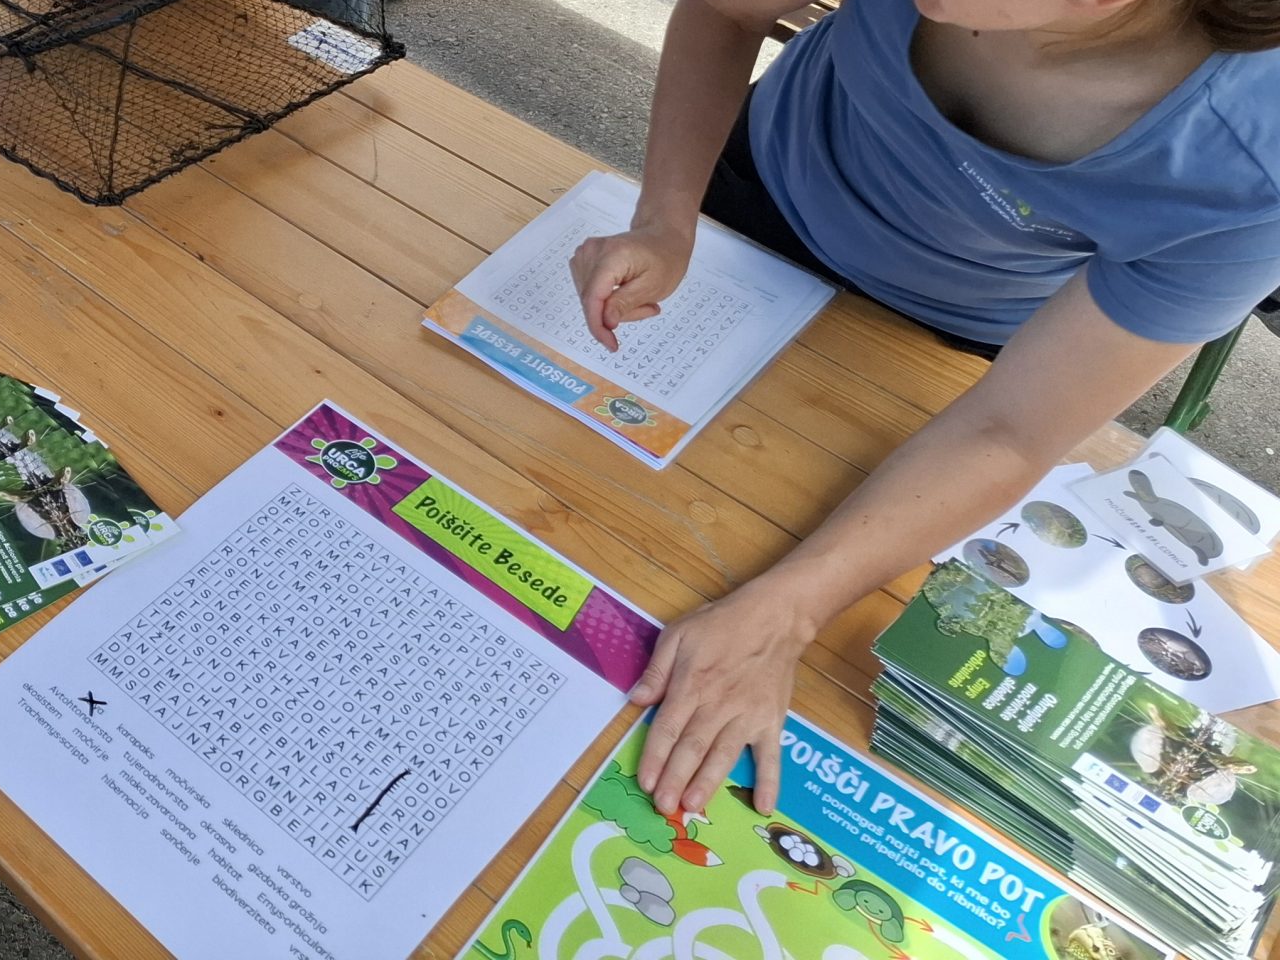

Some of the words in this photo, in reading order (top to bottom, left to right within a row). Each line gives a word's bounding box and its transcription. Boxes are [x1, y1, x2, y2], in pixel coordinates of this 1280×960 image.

[471, 325, 520, 357] BESEDE
[521, 355, 586, 394] POIŠČITE
[319, 455, 360, 483] PROEMYS
[326, 448, 364, 477] URCA
[97, 522, 114, 544] URCA
[415, 496, 491, 554] Poiščite
[494, 549, 566, 607] Besede
[3, 543, 18, 562] Actions
[15, 563, 24, 573] pro
[5, 558, 21, 582] Slovenia
[949, 650, 985, 687] orbicularis
[965, 678, 989, 698] Emys
[983, 677, 1015, 709] sklednice
[1000, 683, 1036, 720] močvirske
[1018, 694, 1056, 732] Ohranjanje
[23, 683, 62, 719] ekosistem
[72, 728, 108, 761] močvirje
[119, 770, 147, 795] mlaka
[146, 794, 196, 839] zavarovana
[208, 848, 242, 881] habitat
[117, 724, 154, 759] karapaks
[165, 768, 210, 808] močvirska
[222, 818, 264, 855] sklednica
[277, 866, 311, 897] varstvo
[101, 774, 149, 819] hibernacija
[160, 829, 200, 865] sončenje
[212, 875, 275, 934] biodiverziteta
[804, 781, 822, 795] Mi
[822, 794, 884, 836] pomagaš
[885, 835, 919, 859] najti
[920, 858, 947, 880] pot,
[950, 875, 964, 888] ki
[965, 887, 989, 905] me
[991, 901, 1010, 918] bo
[822, 807, 859, 834] varno
[861, 834, 925, 878] pripeljala
[927, 877, 946, 891] do
[948, 891, 1005, 928] ribnika?
[872, 793, 975, 869] PRAVO
[980, 862, 1044, 911] POT
[200, 821, 236, 853] okrasna
[247, 864, 289, 901] gizdavka
[288, 900, 327, 934] grožnja
